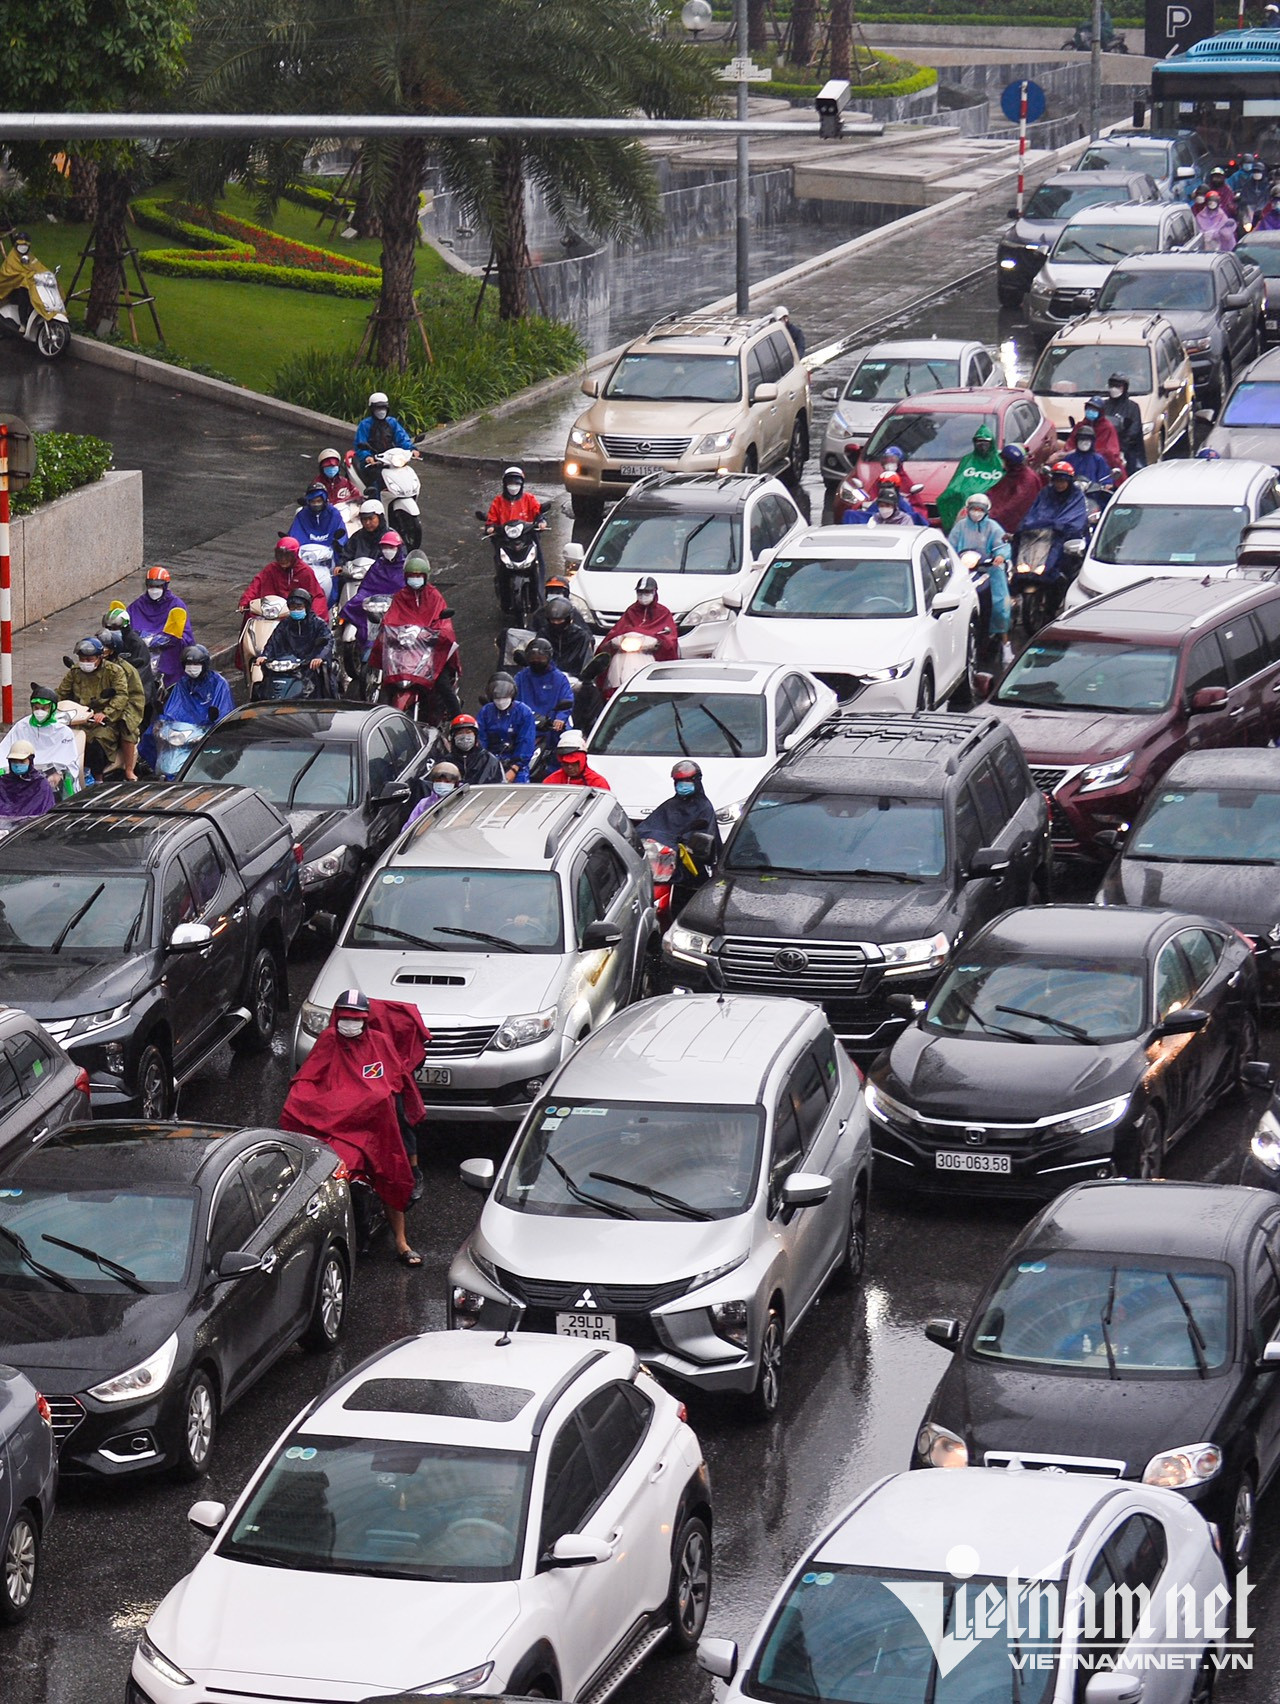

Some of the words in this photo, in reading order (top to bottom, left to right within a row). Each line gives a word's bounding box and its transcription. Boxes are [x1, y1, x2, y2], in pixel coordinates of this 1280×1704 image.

[1166, 5, 1192, 38] P
[963, 466, 1003, 480] Grab
[937, 1153, 1009, 1172] 30G-063.58
[568, 1315, 603, 1328] 29LD
